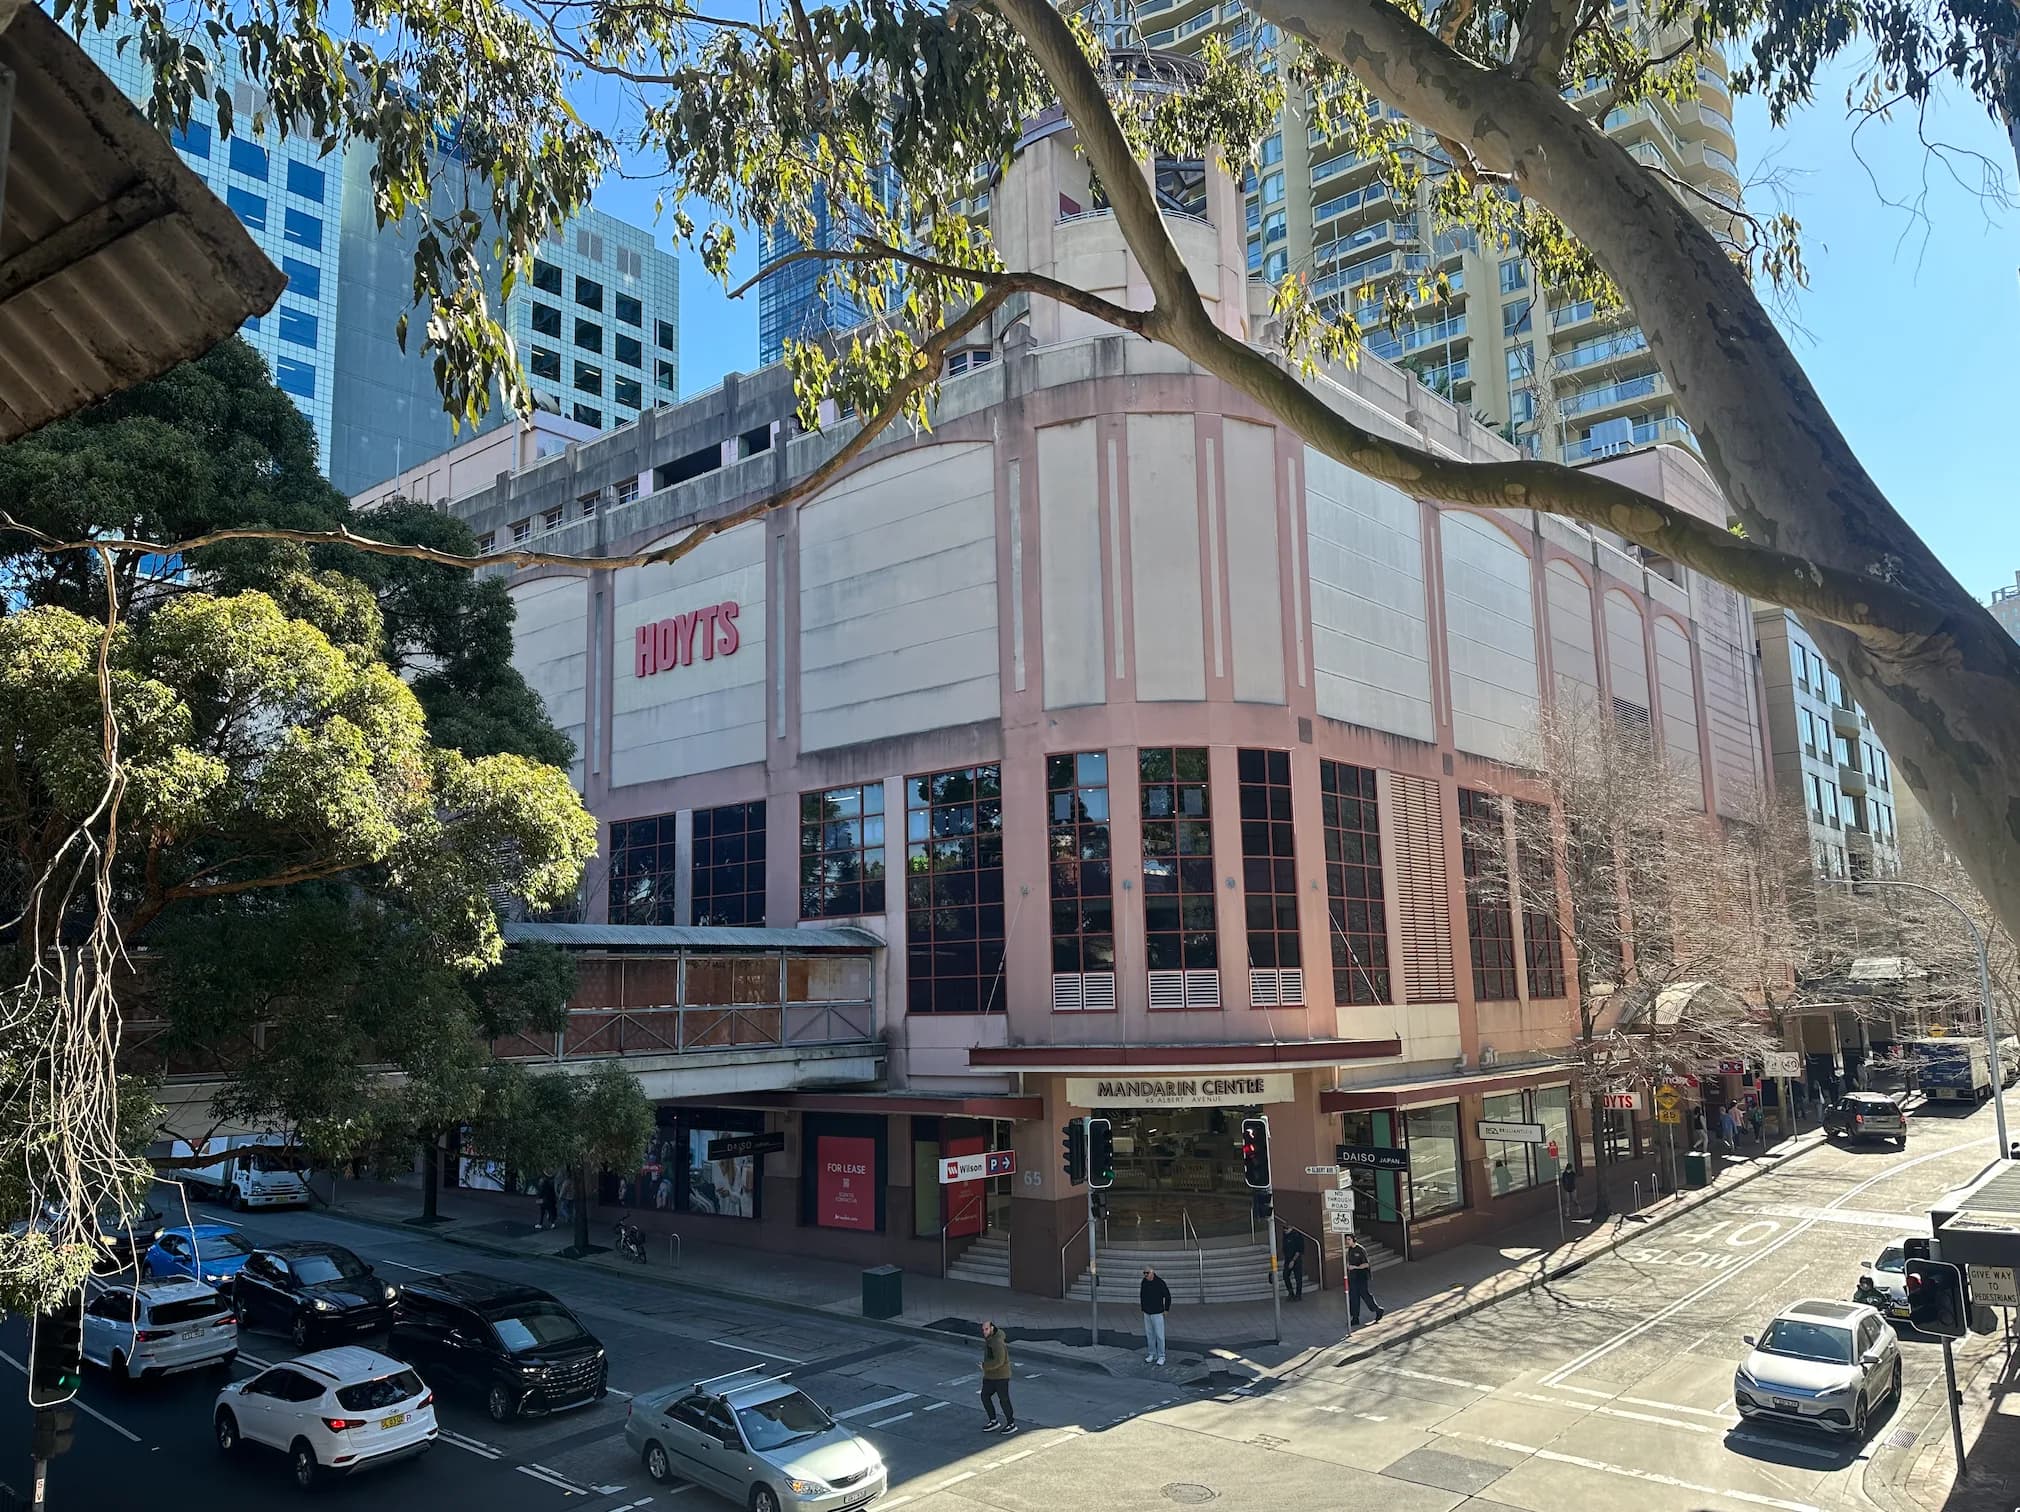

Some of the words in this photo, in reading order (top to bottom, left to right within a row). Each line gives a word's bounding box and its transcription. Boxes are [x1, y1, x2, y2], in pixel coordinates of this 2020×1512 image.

[635, 601, 740, 677] HOYTS
[1097, 1081, 1197, 1097] MANDARIN
[1202, 1078, 1265, 1095] CENTRE
[1191, 1095, 1222, 1103] AVENUE
[1603, 1095, 1632, 1108] OYTS
[1343, 1152, 1376, 1163] DAISO
[1380, 1157, 1400, 1165] JAPAN
[827, 1162, 842, 1173] FOR
[842, 1164, 866, 1175] LEASE
[959, 1163, 982, 1174] Wilson
[990, 1159, 998, 1171] P
[1024, 1170, 1042, 1185] 65
[1625, 1249, 1745, 1270] SLOW
[1971, 1270, 1991, 1279] GIVE
[1993, 1271, 2011, 1280] WAY
[1988, 1282, 1999, 1291] TO
[1975, 1293, 2017, 1303] PEDESTRIANS
